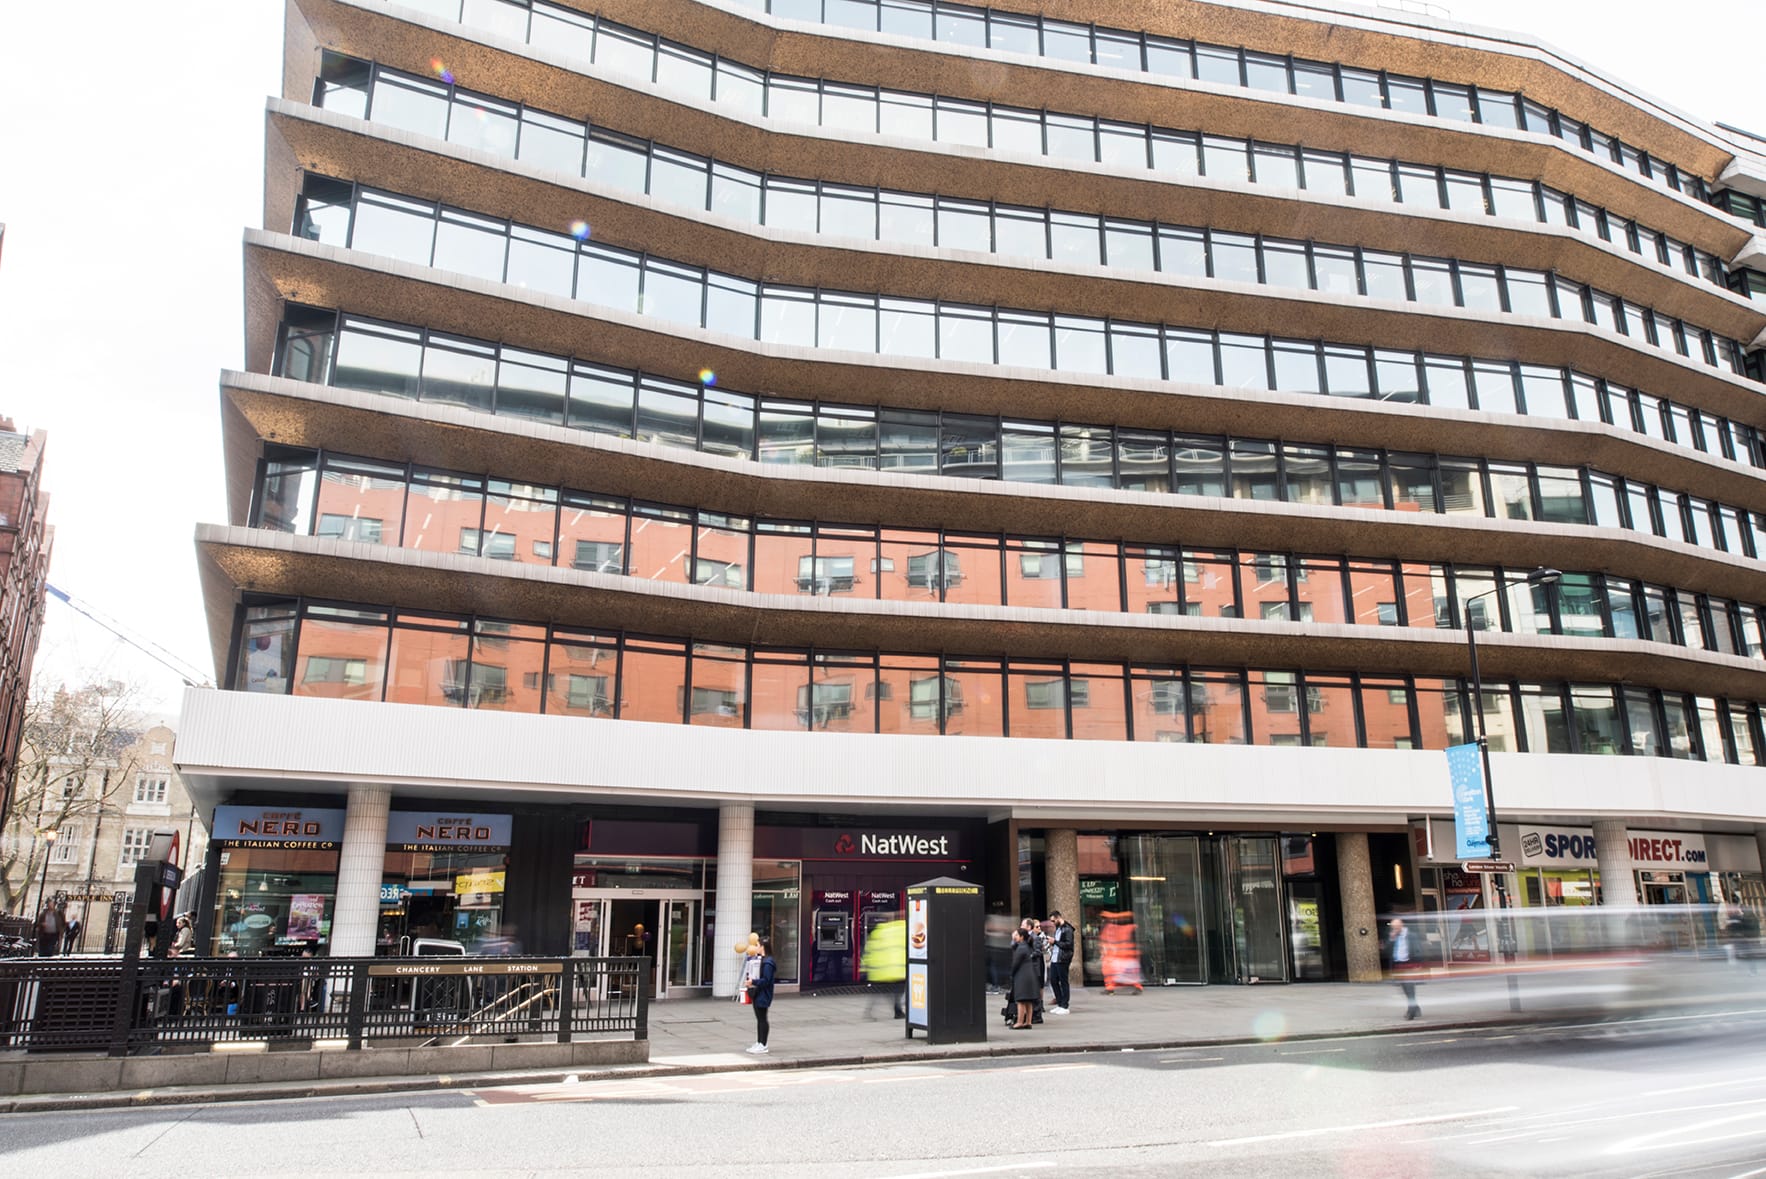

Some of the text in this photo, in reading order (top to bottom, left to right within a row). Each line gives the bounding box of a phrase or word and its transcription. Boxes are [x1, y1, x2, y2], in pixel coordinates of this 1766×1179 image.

[239, 820, 321, 836] NERO
[416, 825, 492, 840] NERO
[244, 840, 280, 848] ITALIAN
[284, 841, 318, 849] COFFEE
[861, 834, 948, 855] NatWest
[1545, 834, 1597, 859] SPOR
